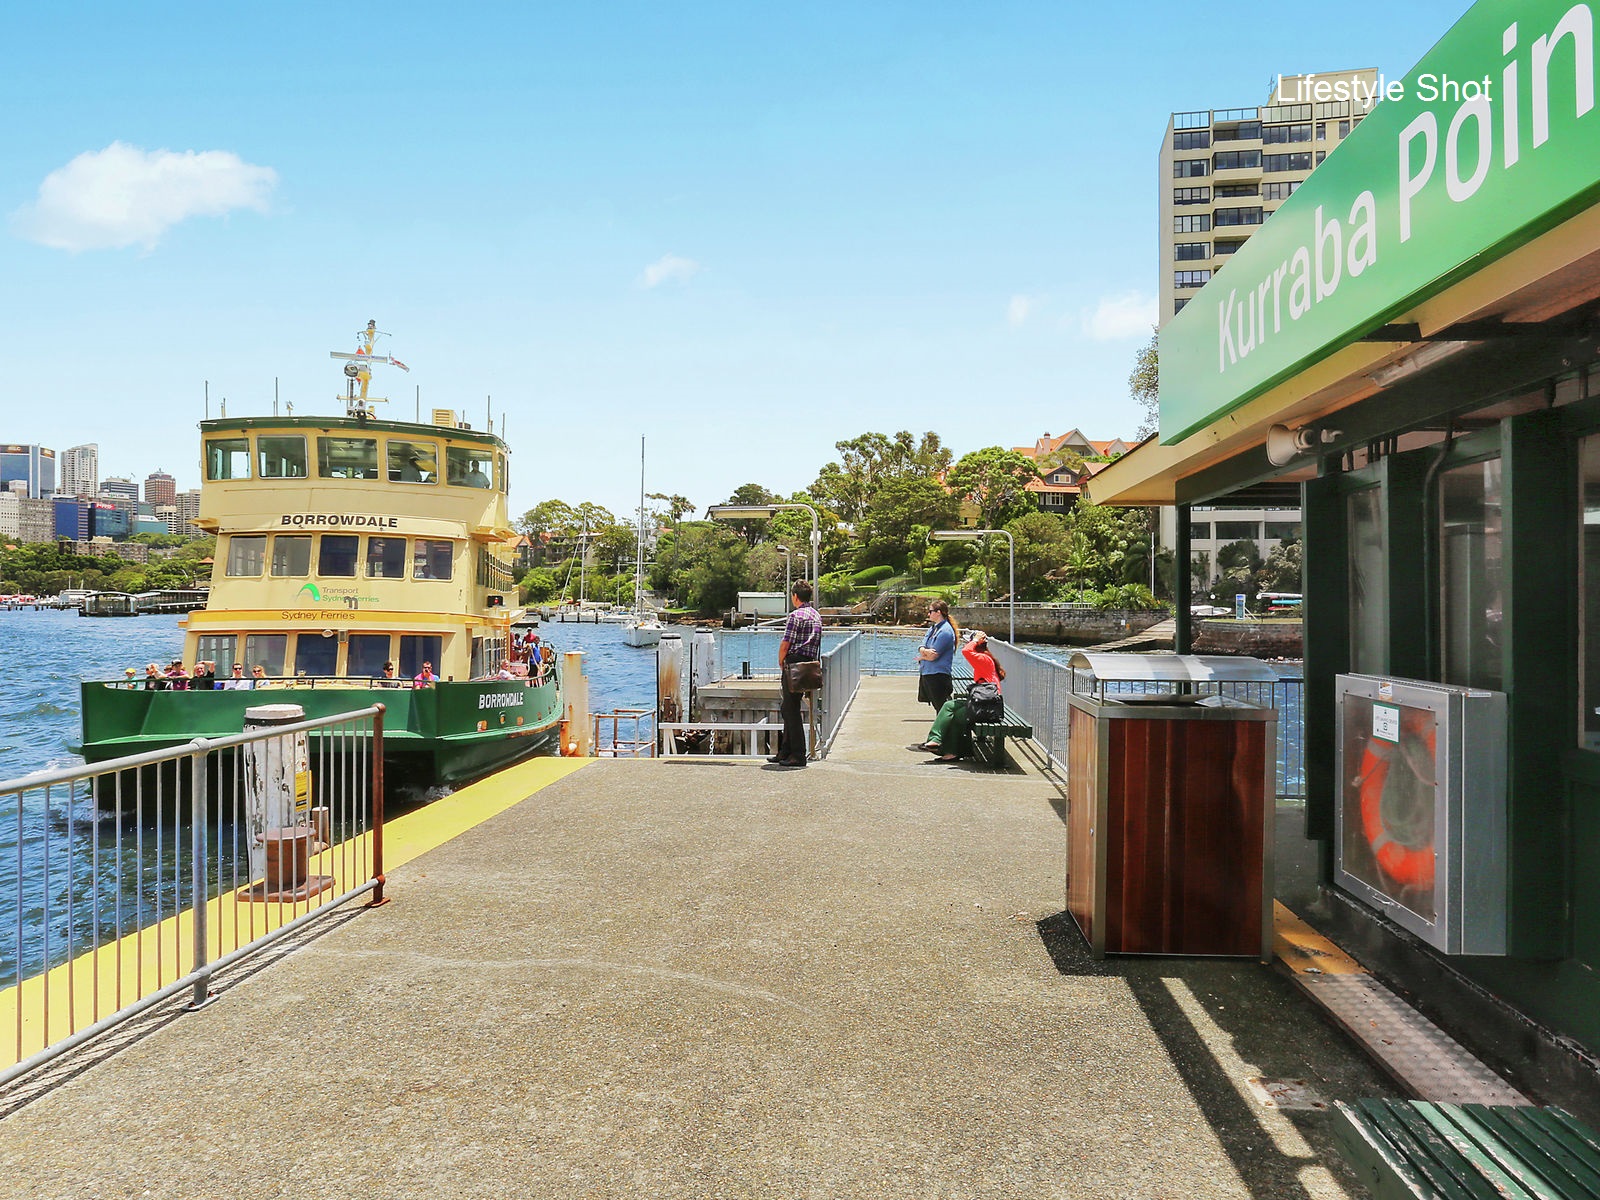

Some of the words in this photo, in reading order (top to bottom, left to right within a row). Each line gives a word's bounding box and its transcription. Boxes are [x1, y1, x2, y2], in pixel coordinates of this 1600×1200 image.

[1219, 190, 1377, 374] Kurraba
[281, 514, 398, 528] BORROWDALE
[322, 586, 358, 596] Transport
[322, 594, 350, 603] Sydne
[281, 611, 317, 621] Sydney
[320, 611, 355, 620] Ferries
[478, 692, 524, 710] BORROWDALE
